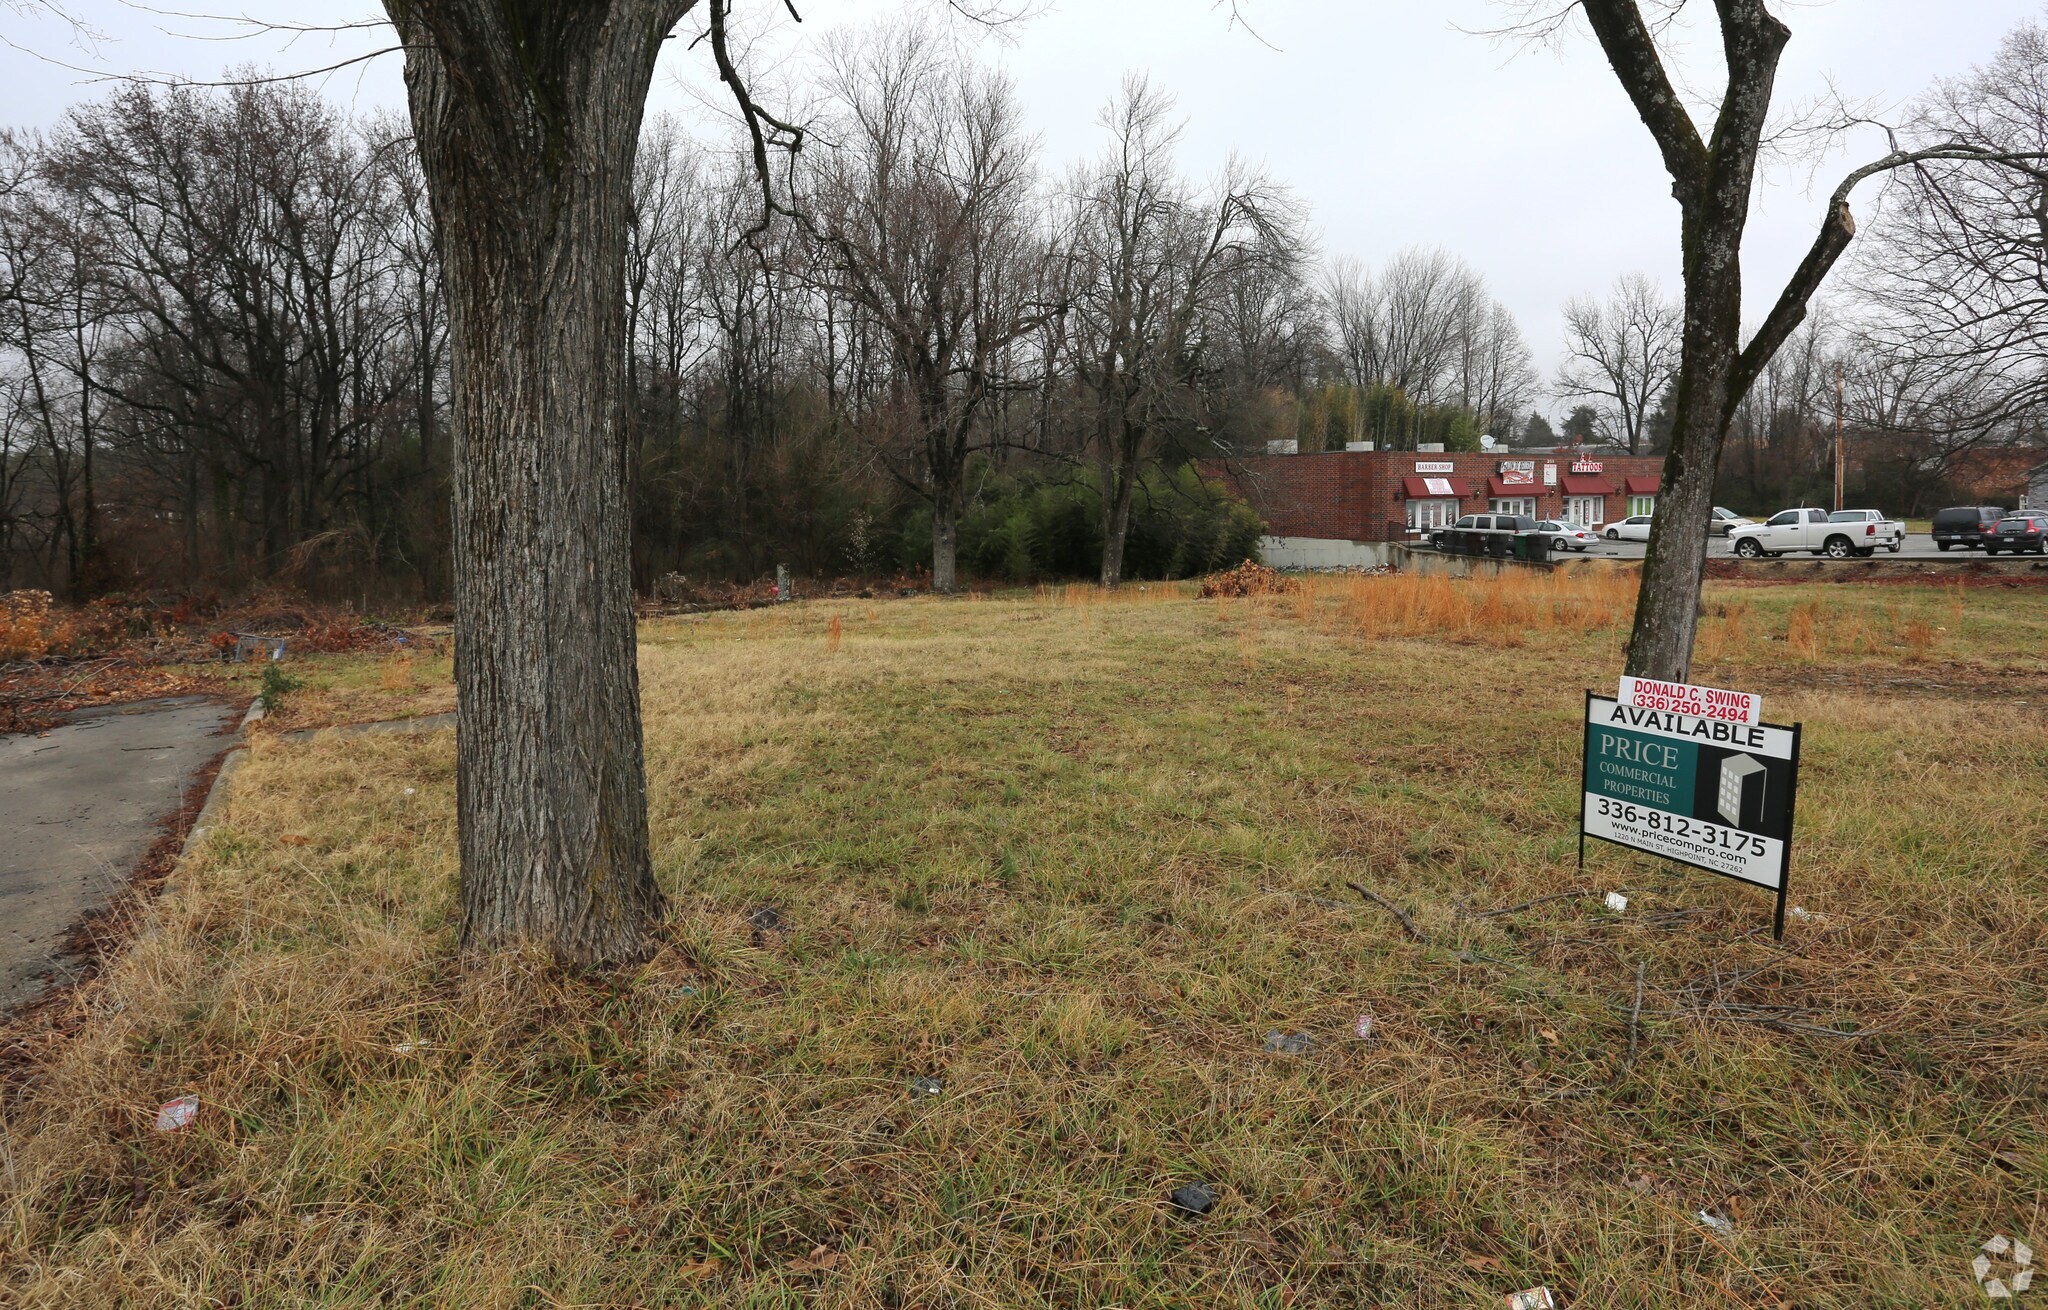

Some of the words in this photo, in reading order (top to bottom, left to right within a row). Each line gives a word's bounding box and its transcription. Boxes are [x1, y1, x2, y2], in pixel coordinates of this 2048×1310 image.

[1417, 463, 1437, 471] BARBER
[1438, 463, 1451, 471] SHOP
[1572, 463, 1602, 472] TATTOOS
[1634, 680, 1686, 699] DONALD
[1689, 688, 1702, 702] C.
[1705, 690, 1751, 709] SWING
[1610, 705, 1765, 749] AVAILABLE
[1600, 733, 1679, 770] PRICE
[1600, 761, 1677, 788] COMMERCIAL
[1604, 779, 1670, 805] PROPERTIES
[1598, 798, 1767, 857] 336-812-3175
[1611, 821, 1747, 865] www.pricecompro.com
[1614, 832, 1629, 841] 1220
[1637, 838, 1654, 848] MAIN
[1667, 848, 1706, 864] HIGHPOINT,
[1708, 859, 1719, 867] NC
[1721, 862, 1743, 873] 27262
